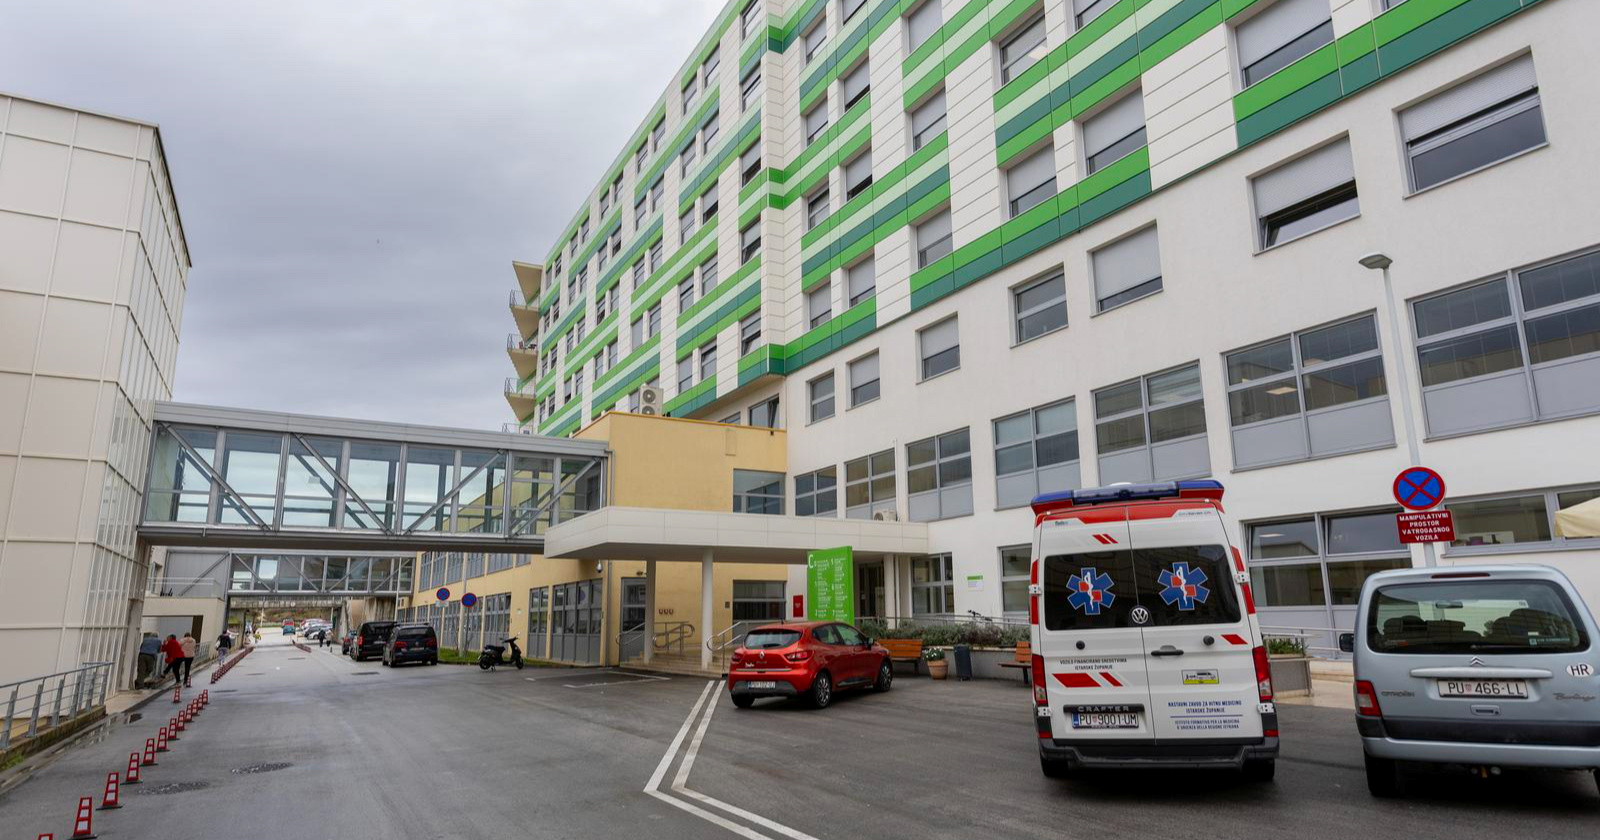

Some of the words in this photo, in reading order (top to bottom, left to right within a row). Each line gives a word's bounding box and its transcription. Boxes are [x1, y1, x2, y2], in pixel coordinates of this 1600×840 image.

[1399, 513, 1448, 521] MANIPULATIVNI
[1402, 526, 1450, 535] VATROGASNOG
[808, 554, 814, 569] C
[1570, 663, 1590, 676] HR
[1448, 682, 1465, 694] PU
[1080, 714, 1092, 725] PU
